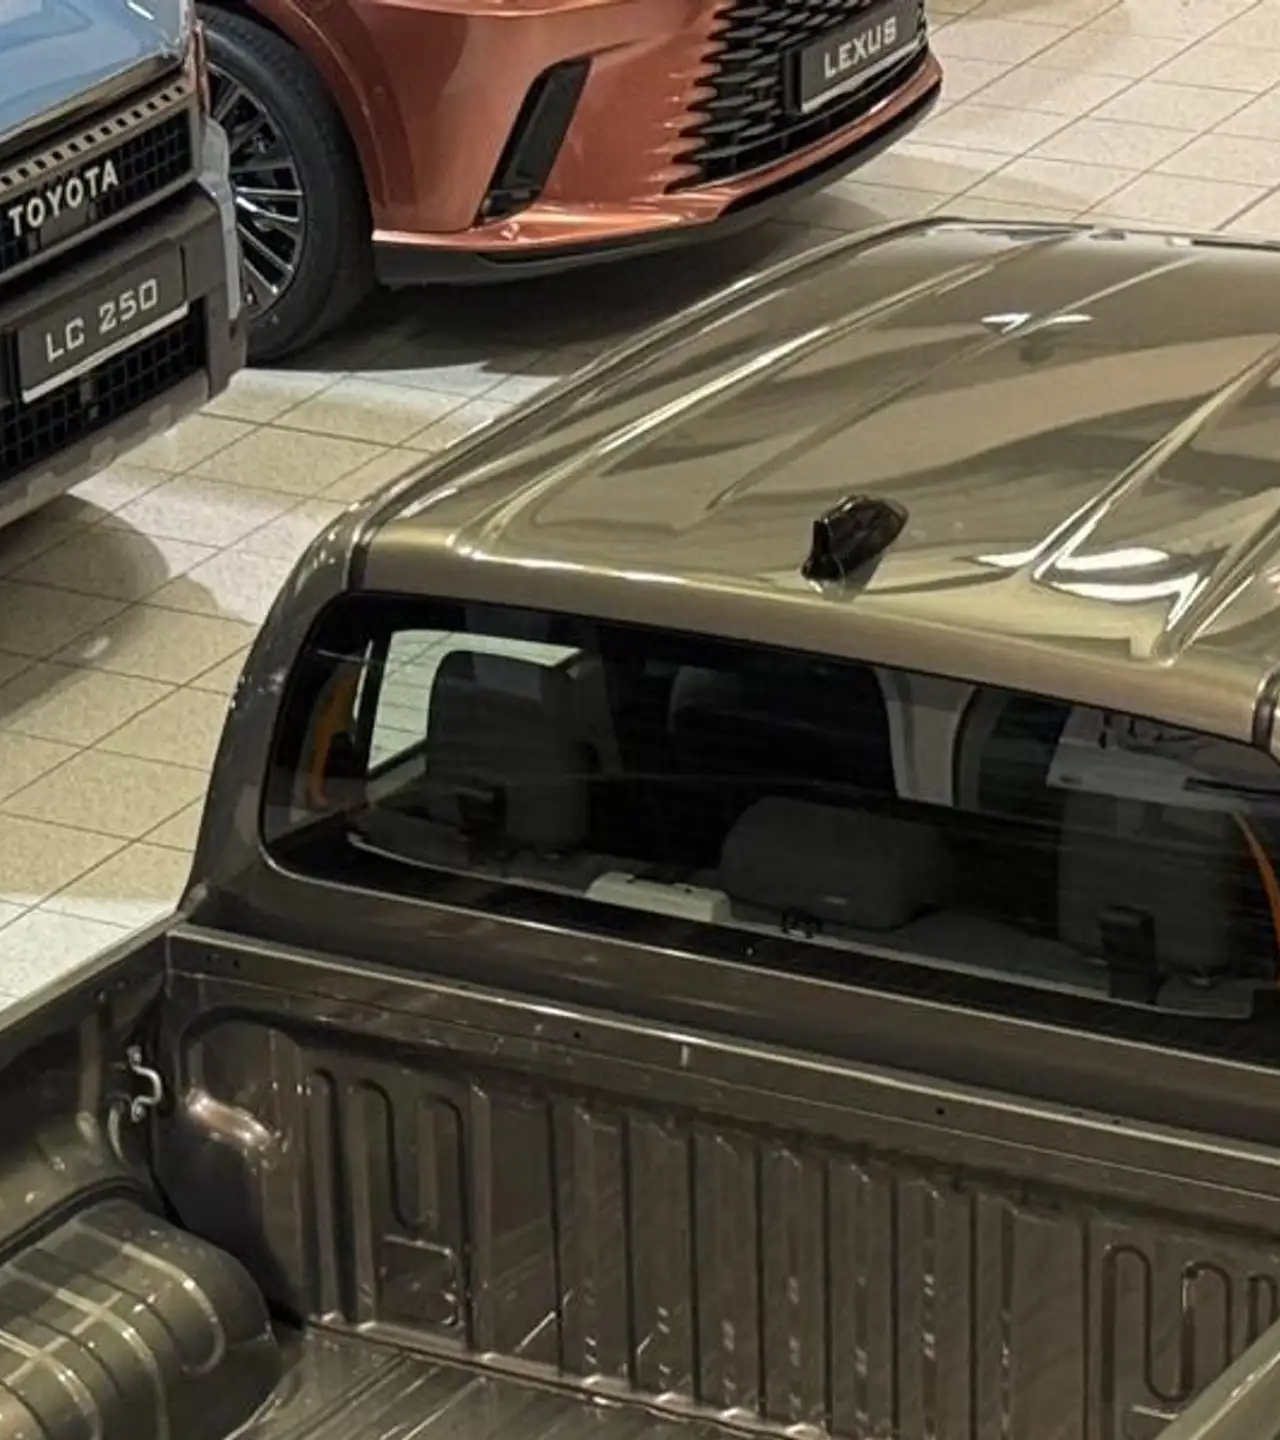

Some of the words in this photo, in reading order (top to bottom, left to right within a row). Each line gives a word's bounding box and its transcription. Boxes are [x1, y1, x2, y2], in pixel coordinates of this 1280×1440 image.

[824, 16, 897, 79] LEXUS
[7, 159, 119, 237] TOYOTA
[45, 316, 85, 363] LC
[98, 277, 158, 334] 250
